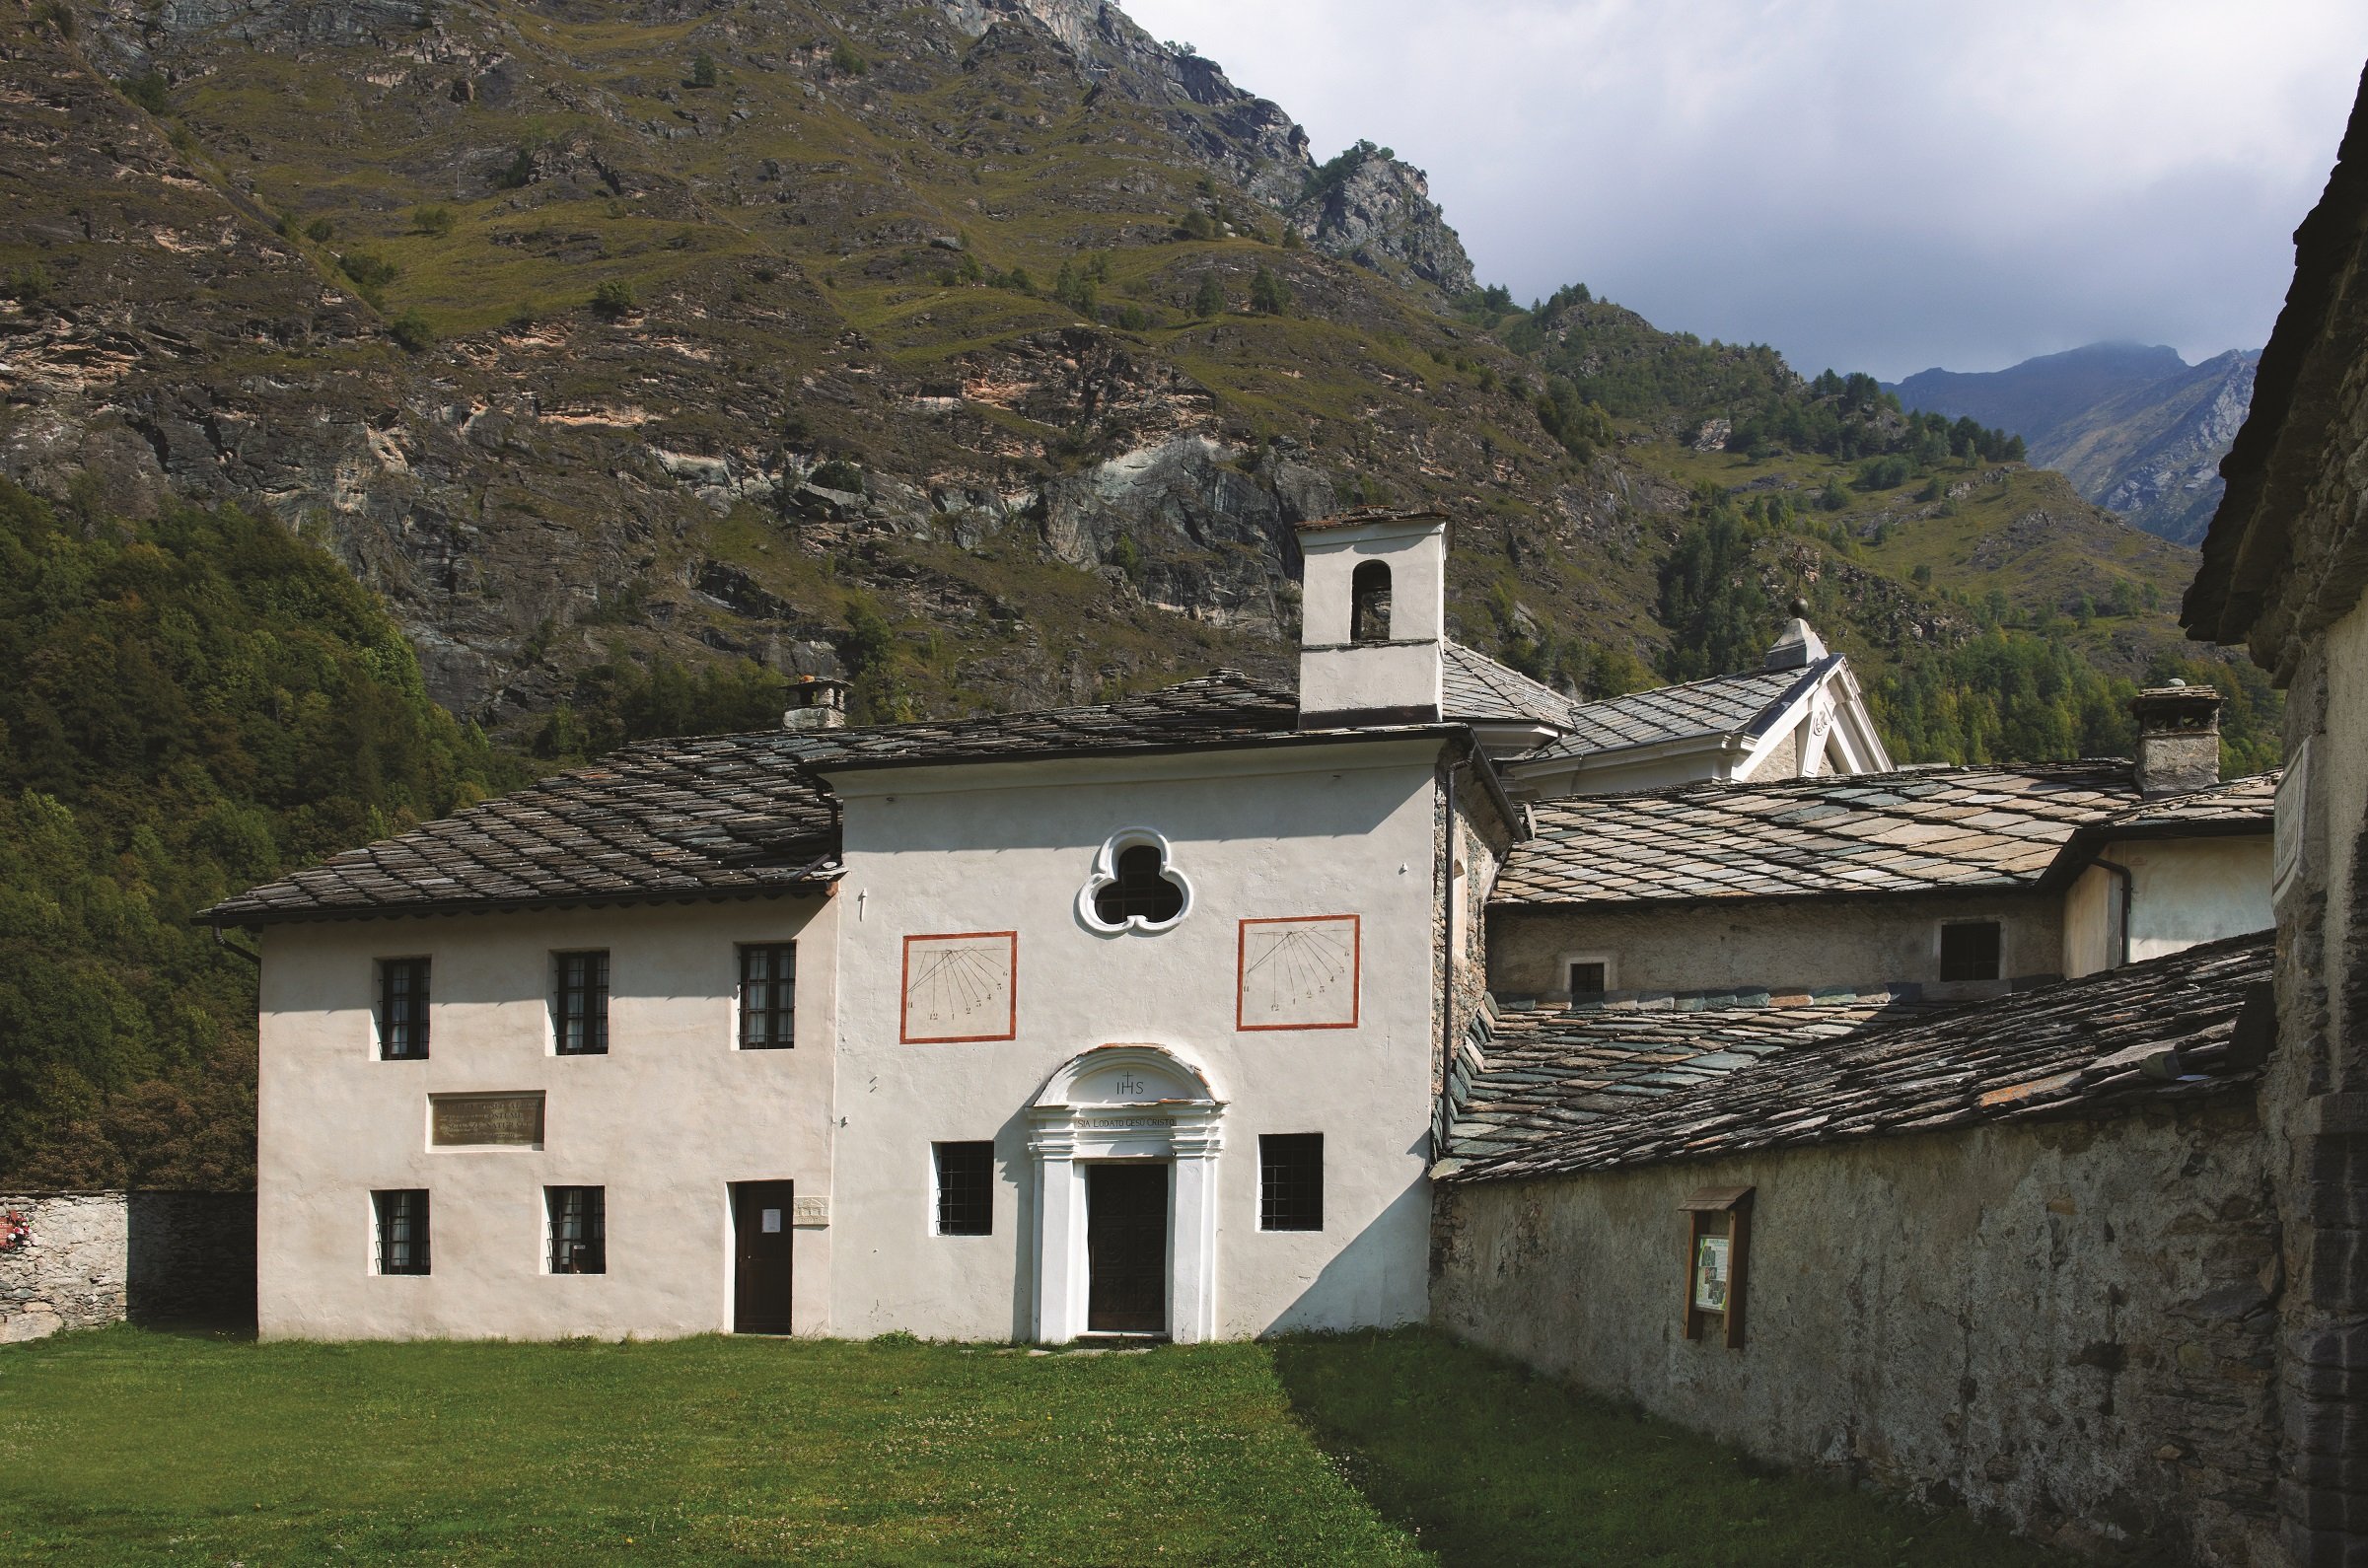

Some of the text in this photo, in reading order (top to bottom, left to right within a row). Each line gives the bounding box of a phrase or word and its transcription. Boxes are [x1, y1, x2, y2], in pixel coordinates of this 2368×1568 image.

[1116, 1081, 1144, 1095] IHS
[1077, 1118, 1091, 1127] SIA
[1093, 1118, 1124, 1127] LODATO
[1146, 1117, 1175, 1127] CRISTO
